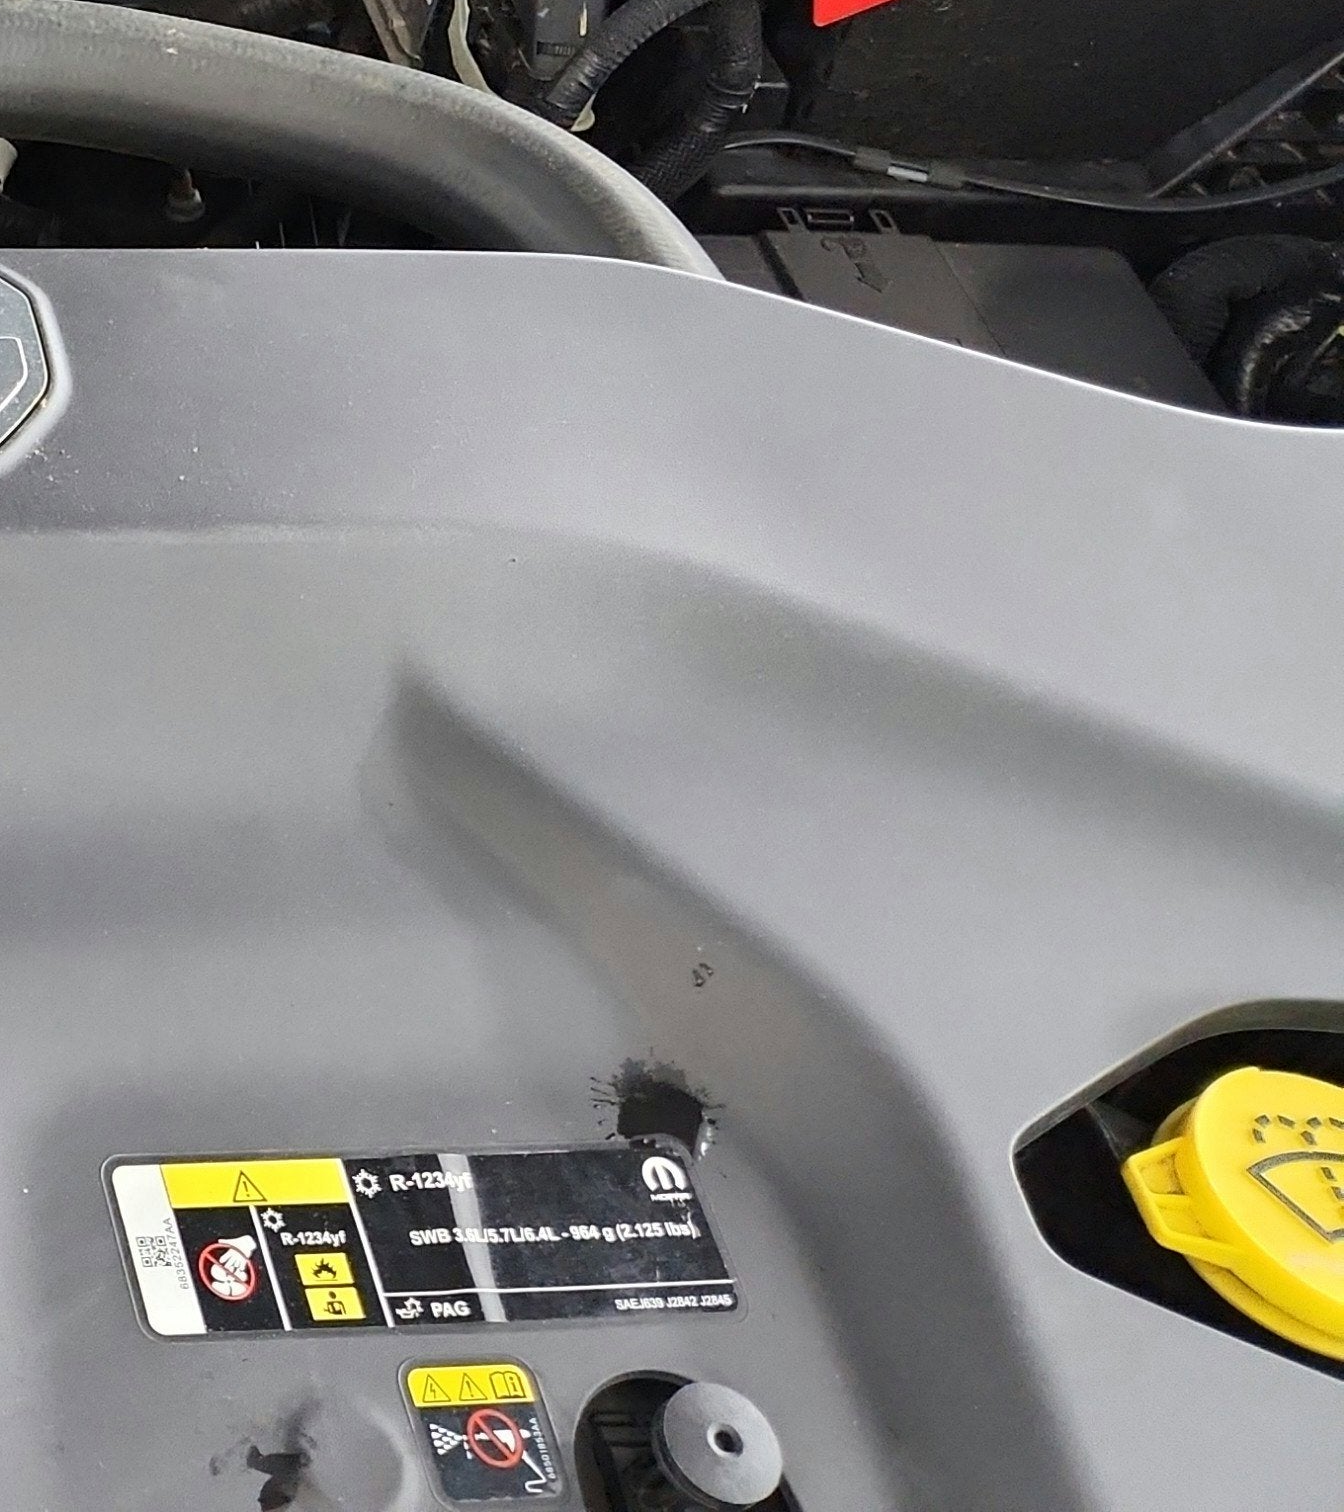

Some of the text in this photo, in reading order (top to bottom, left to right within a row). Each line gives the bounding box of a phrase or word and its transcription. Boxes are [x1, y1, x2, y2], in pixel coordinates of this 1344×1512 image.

[388, 1171, 473, 1193] R-1234yf
[280, 1230, 347, 1247] R-1234yf
[409, 1229, 452, 1246] SWB
[615, 1222, 663, 1241] (2.125
[431, 1300, 472, 1318] PAG
